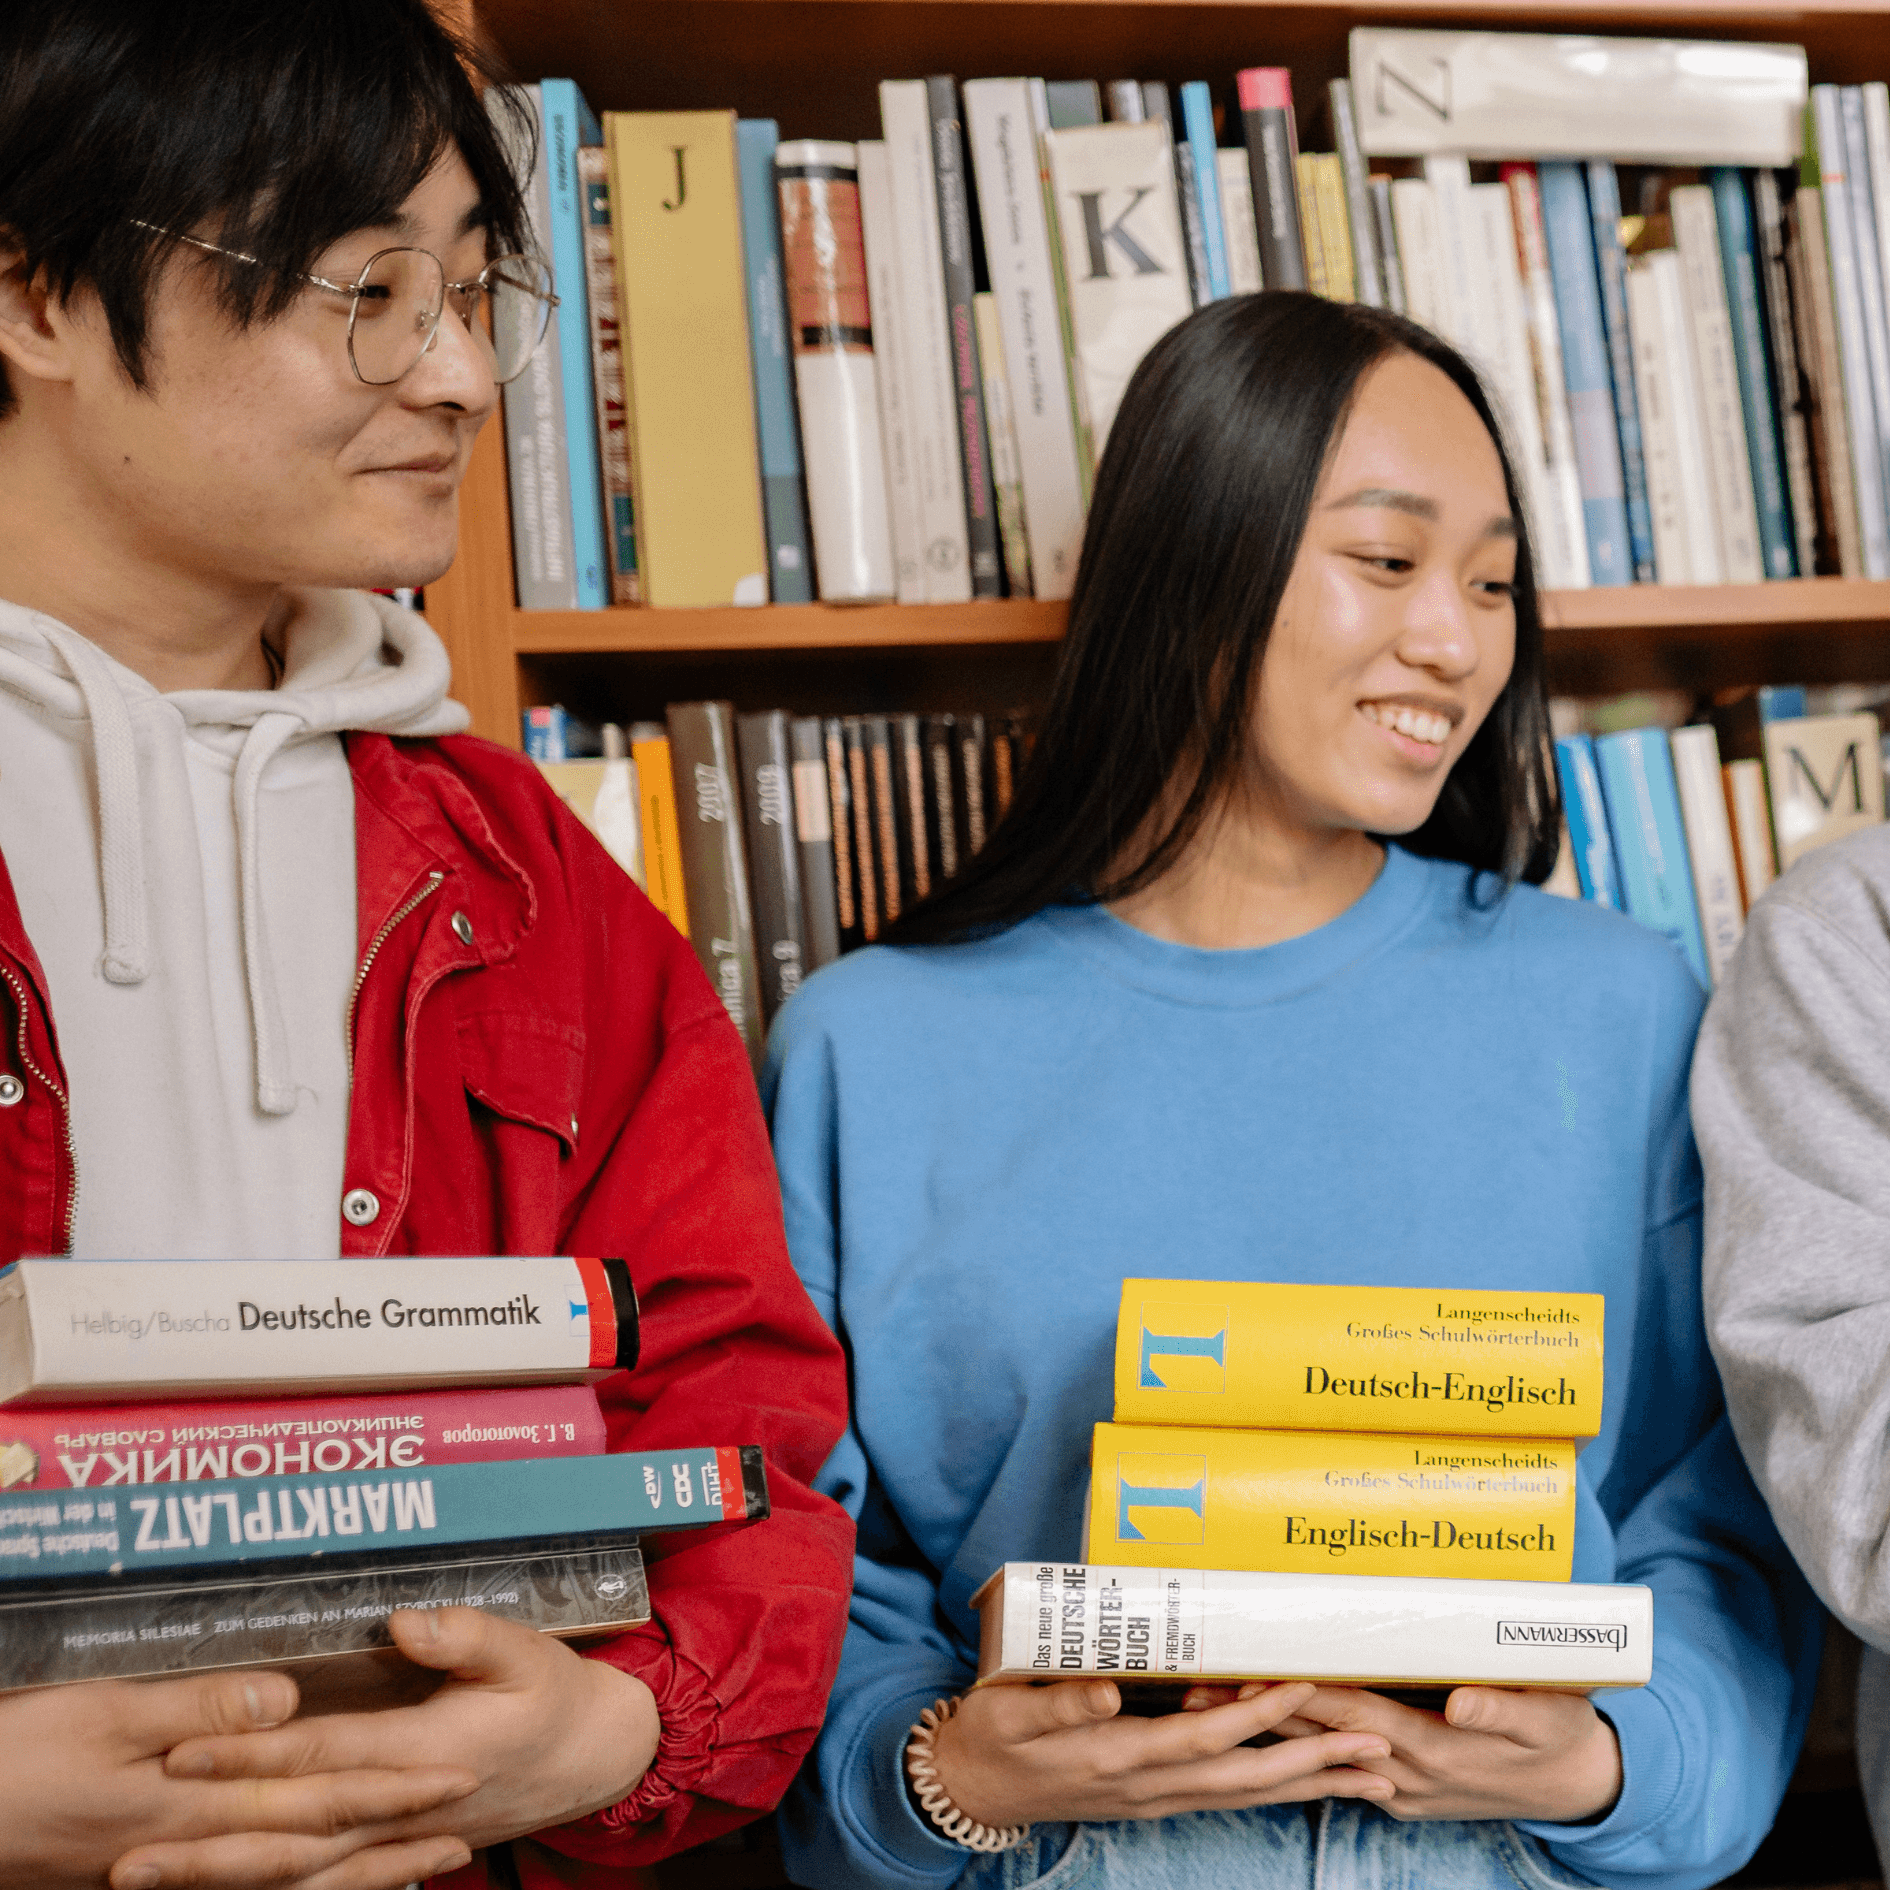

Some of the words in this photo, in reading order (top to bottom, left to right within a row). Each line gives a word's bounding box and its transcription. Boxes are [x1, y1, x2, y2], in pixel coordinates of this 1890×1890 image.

[662, 146, 689, 211] J
[1073, 185, 1173, 282] K
[696, 762, 728, 823] 2007
[1788, 741, 1866, 815] M
[70, 1309, 231, 1340] Helbig/Buscha
[239, 1297, 372, 1332] Deutsche
[380, 1294, 542, 1330] Grammatik
[1436, 1303, 1580, 1325] Langenscheidts
[1347, 1321, 1413, 1341] Großes
[1418, 1324, 1580, 1348] Schulwörterbuch
[1303, 1365, 1577, 1413] Deutsch-Englisch
[54, 1425, 166, 1446] СЛОВАРЬ
[171, 1414, 424, 1445] ЭНЦИКЛОПЕДИЧЕСКИЙ
[442, 1425, 540, 1447] Золотогоров
[543, 1424, 555, 1443] Г.
[557, 1422, 576, 1442] В.
[58, 1434, 425, 1488] ЭКОНОМИКА
[1413, 1450, 1558, 1471] Langenscheidts
[1324, 1470, 1391, 1489] Großes
[1397, 1471, 1558, 1495] Schulwörterbuch
[97, 1502, 117, 1521] in
[130, 1481, 436, 1552] MARKTPLATZ
[1282, 1515, 1556, 1557] Englisch-Deutsch
[1037, 1566, 1056, 1604] große
[63, 1630, 135, 1650] MEMORIA
[139, 1622, 201, 1641] SILESIAE
[213, 1618, 244, 1634] ZUM
[247, 1609, 318, 1630] GEDENKEN
[321, 1609, 341, 1623] AN
[344, 1603, 393, 1619] MARIAN
[1038, 1606, 1052, 1639] neue
[1060, 1567, 1087, 1670] DEUTSCHE
[1091, 1577, 1122, 1671] WÖRTER-
[1164, 1578, 1181, 1661] FREMDWÖRTER-
[1033, 1644, 1053, 1669] Das
[1126, 1616, 1151, 1671] BUCH
[1183, 1633, 1196, 1661] BUCH
[1165, 1664, 1177, 1672] &
